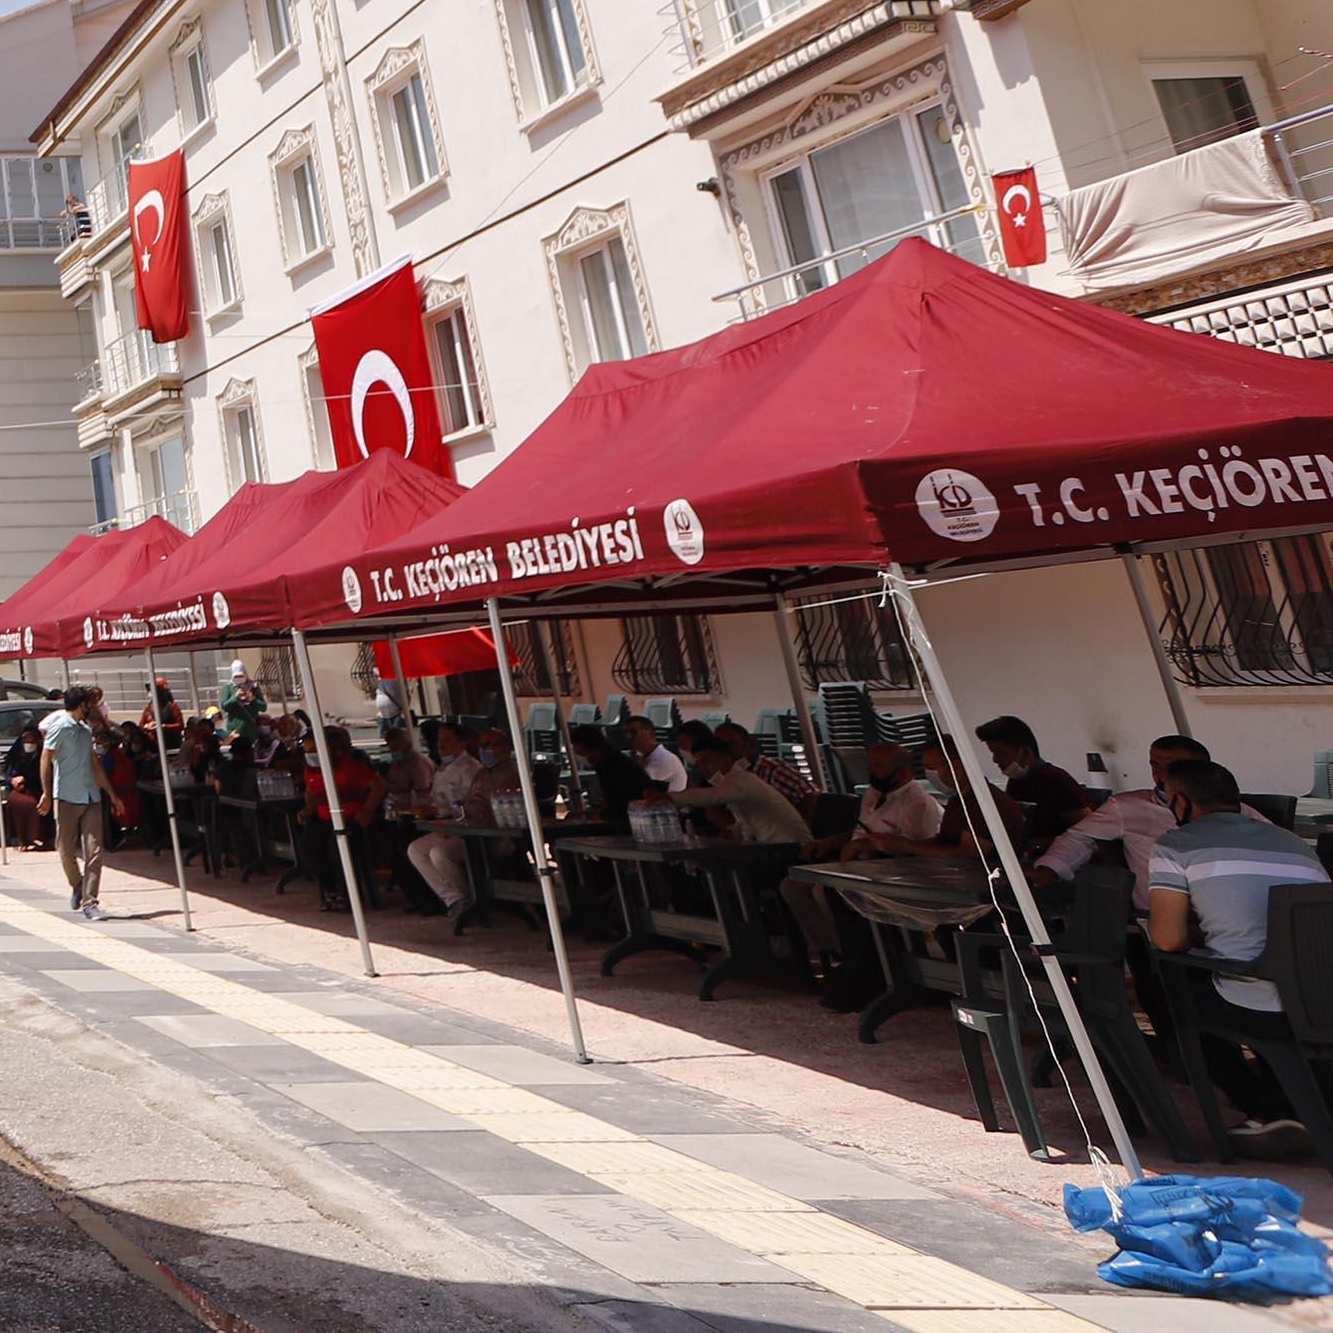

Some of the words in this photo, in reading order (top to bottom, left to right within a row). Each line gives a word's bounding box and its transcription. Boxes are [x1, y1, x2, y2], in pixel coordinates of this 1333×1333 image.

[1014, 477, 1109, 527] T.C.
[370, 567, 403, 602] T.C.
[404, 544, 498, 602] KEÇİÖREN
[506, 506, 644, 579] BELEDİYESİ
